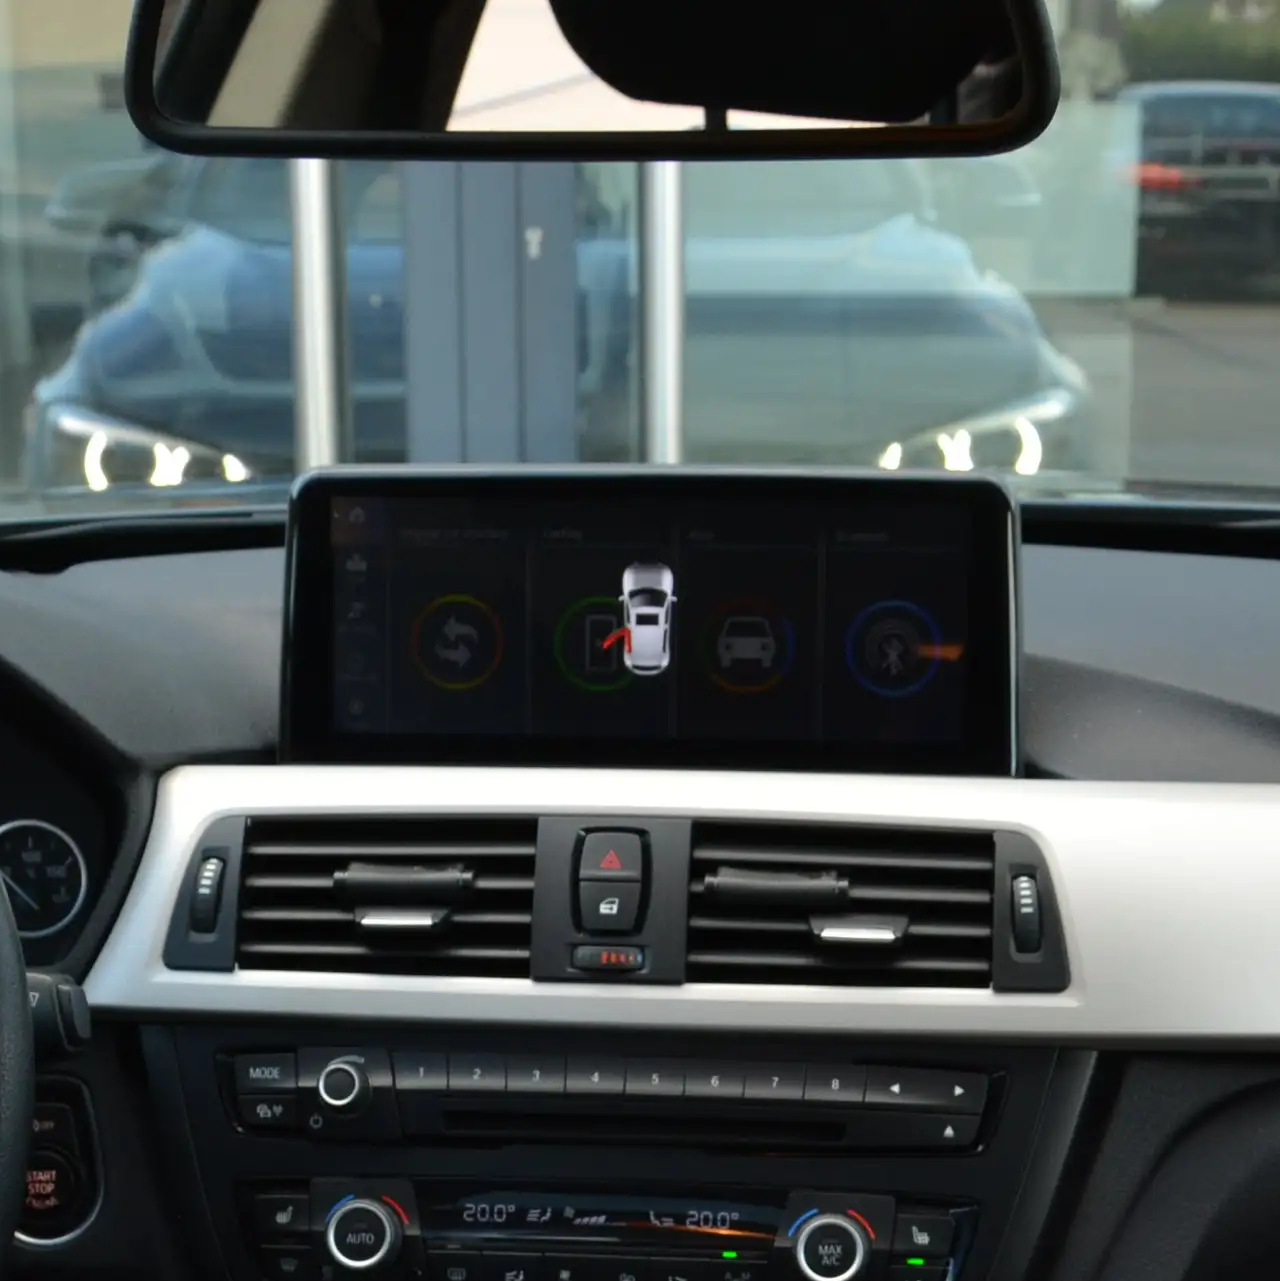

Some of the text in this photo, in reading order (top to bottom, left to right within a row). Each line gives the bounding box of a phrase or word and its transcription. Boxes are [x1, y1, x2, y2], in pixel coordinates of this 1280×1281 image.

[249, 1066, 281, 1080] MODE
[418, 1067, 840, 1091] 1 2 3 4 5 6 7 8
[27, 1182, 55, 1195] STOP
[345, 1232, 375, 1245] AUTO
[817, 1243, 842, 1256] MAX
